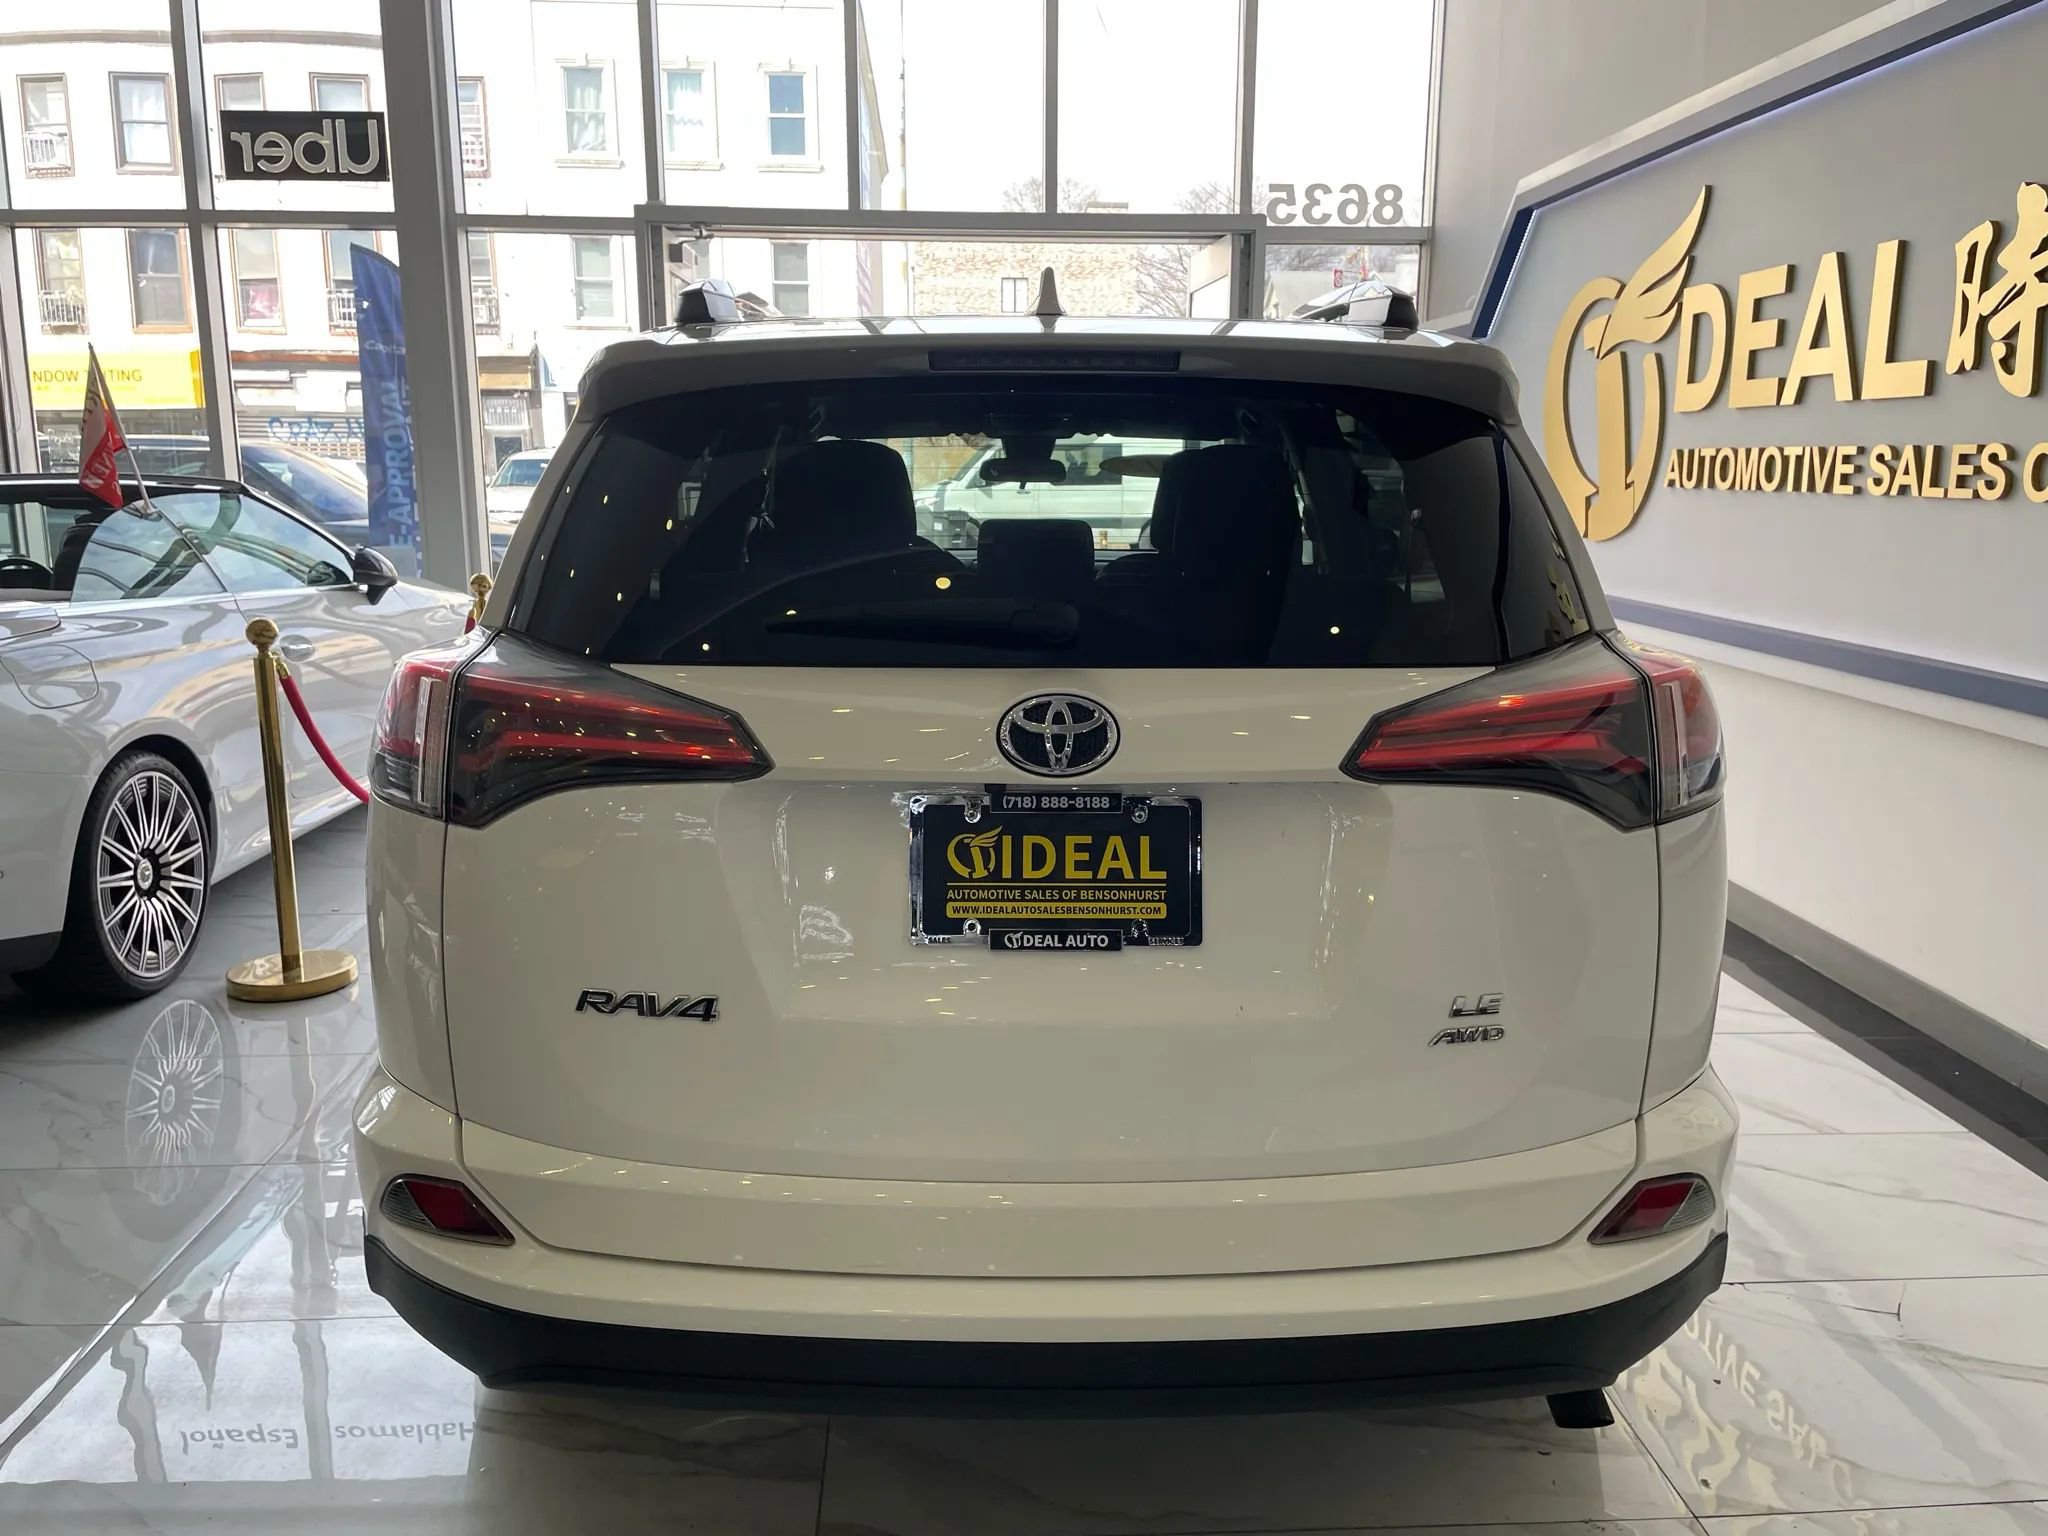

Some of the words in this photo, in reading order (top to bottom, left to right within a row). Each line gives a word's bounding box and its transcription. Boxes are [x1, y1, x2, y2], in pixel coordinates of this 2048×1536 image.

[364, 340, 406, 355] Capita
[33, 370, 79, 382] NDOW
[84, 369, 142, 382] TING
[381, 379, 414, 546] E-APPROVAL
[1664, 445, 1863, 496] AUTOMOTIVE
[1866, 442, 2013, 501] SALES
[1002, 795, 1037, 809] (718)
[1041, 796, 1110, 809] 888-8188
[1002, 835, 1167, 880] IDEAL
[946, 889, 1022, 900] AUTOMOTIVE
[1024, 889, 1059, 900] SALES
[1063, 889, 1077, 900] OF
[1080, 889, 1167, 900] BENSONHURST
[952, 905, 1162, 916] WWW.IDEALAUTOSALESBENSONHURST.COM
[1067, 934, 1109, 948] AUTO
[575, 988, 720, 1024] RAV4
[1449, 992, 1504, 1018] LE
[1428, 1024, 1505, 1048] AWD
